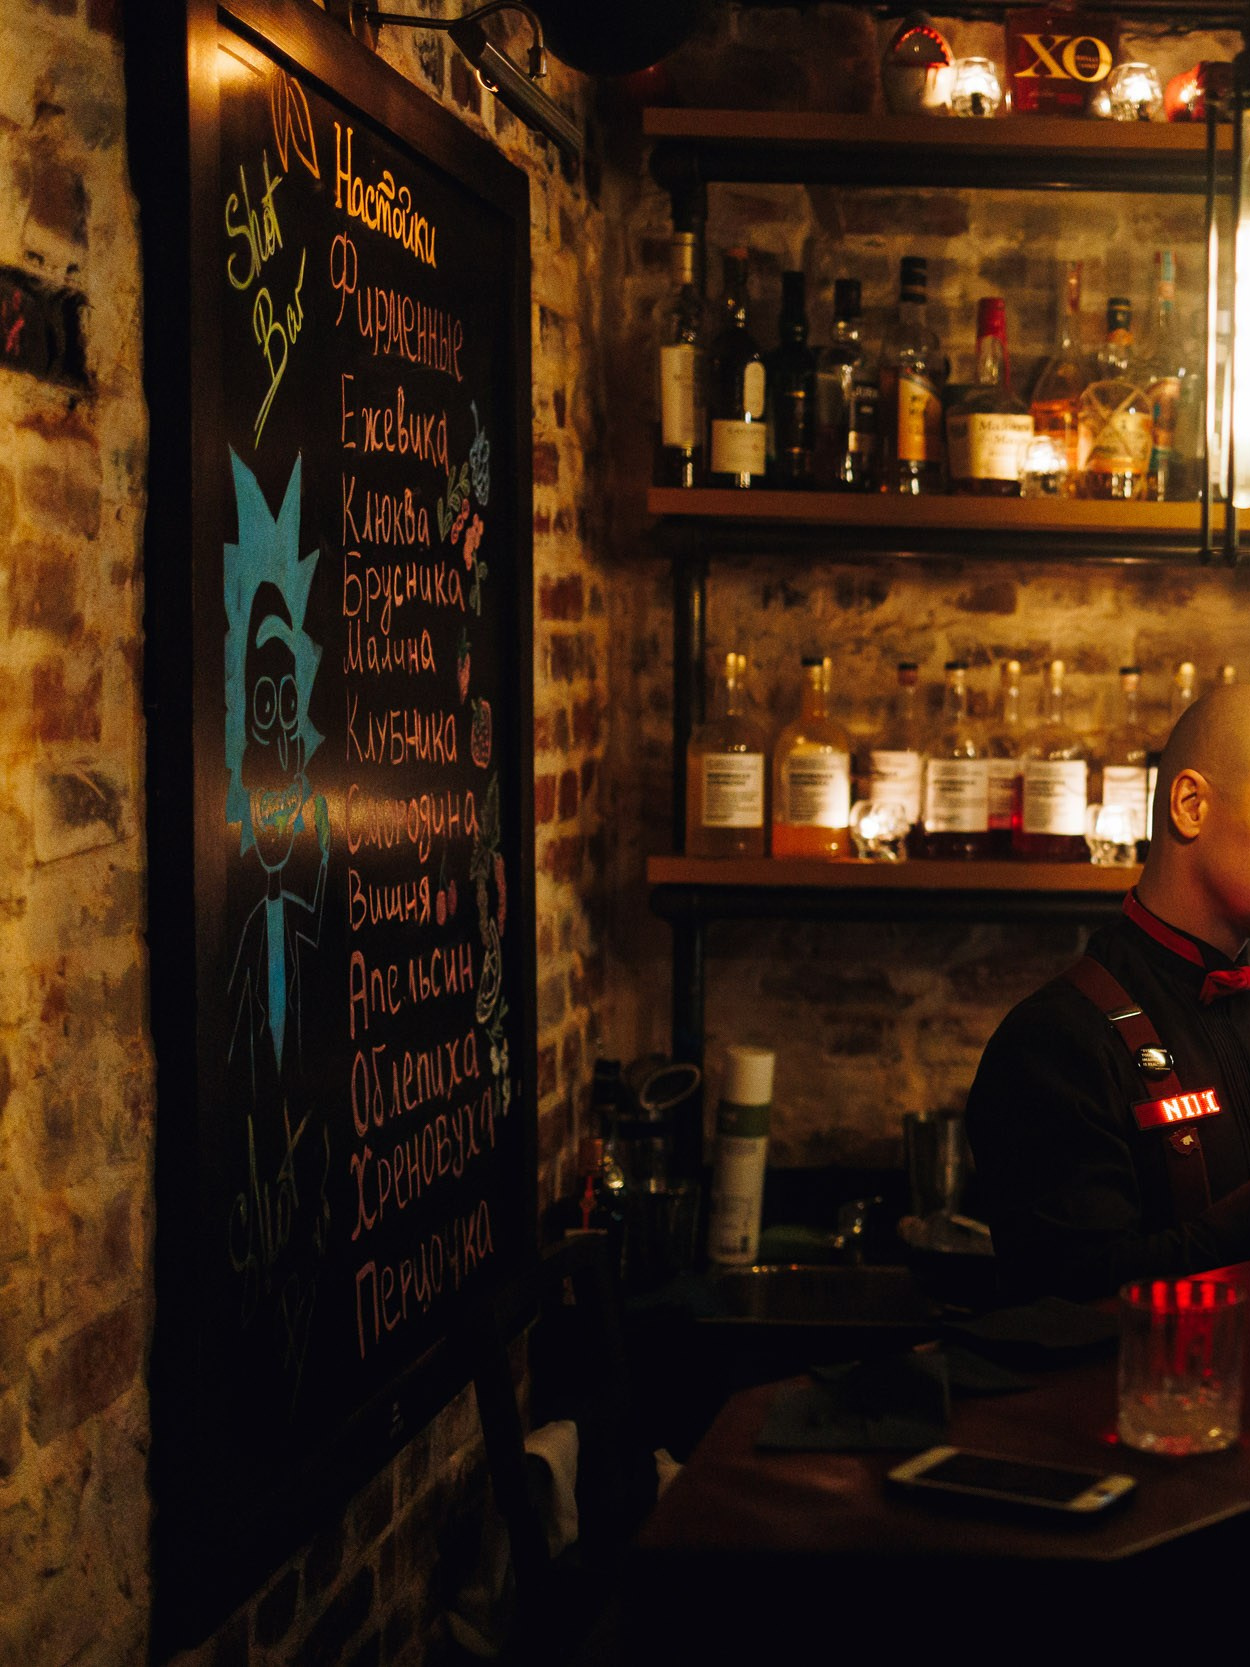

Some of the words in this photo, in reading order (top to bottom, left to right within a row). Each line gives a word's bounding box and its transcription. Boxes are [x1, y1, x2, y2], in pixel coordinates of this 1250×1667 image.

[1013, 34, 1112, 83] XO
[225, 150, 283, 290] Shot
[334, 121, 437, 268] Настойки
[253, 247, 306, 449] Bar
[330, 232, 464, 382] Фирменные
[341, 373, 449, 475] Ежевика
[342, 473, 430, 547] Клюква
[342, 551, 466, 635] Брусника
[344, 621, 435, 675] Малина
[346, 786, 479, 863] Смородина
[348, 867, 431, 932] Вишня
[350, 943, 475, 1040] Апельсин
[351, 1028, 480, 1137] Облепиха
